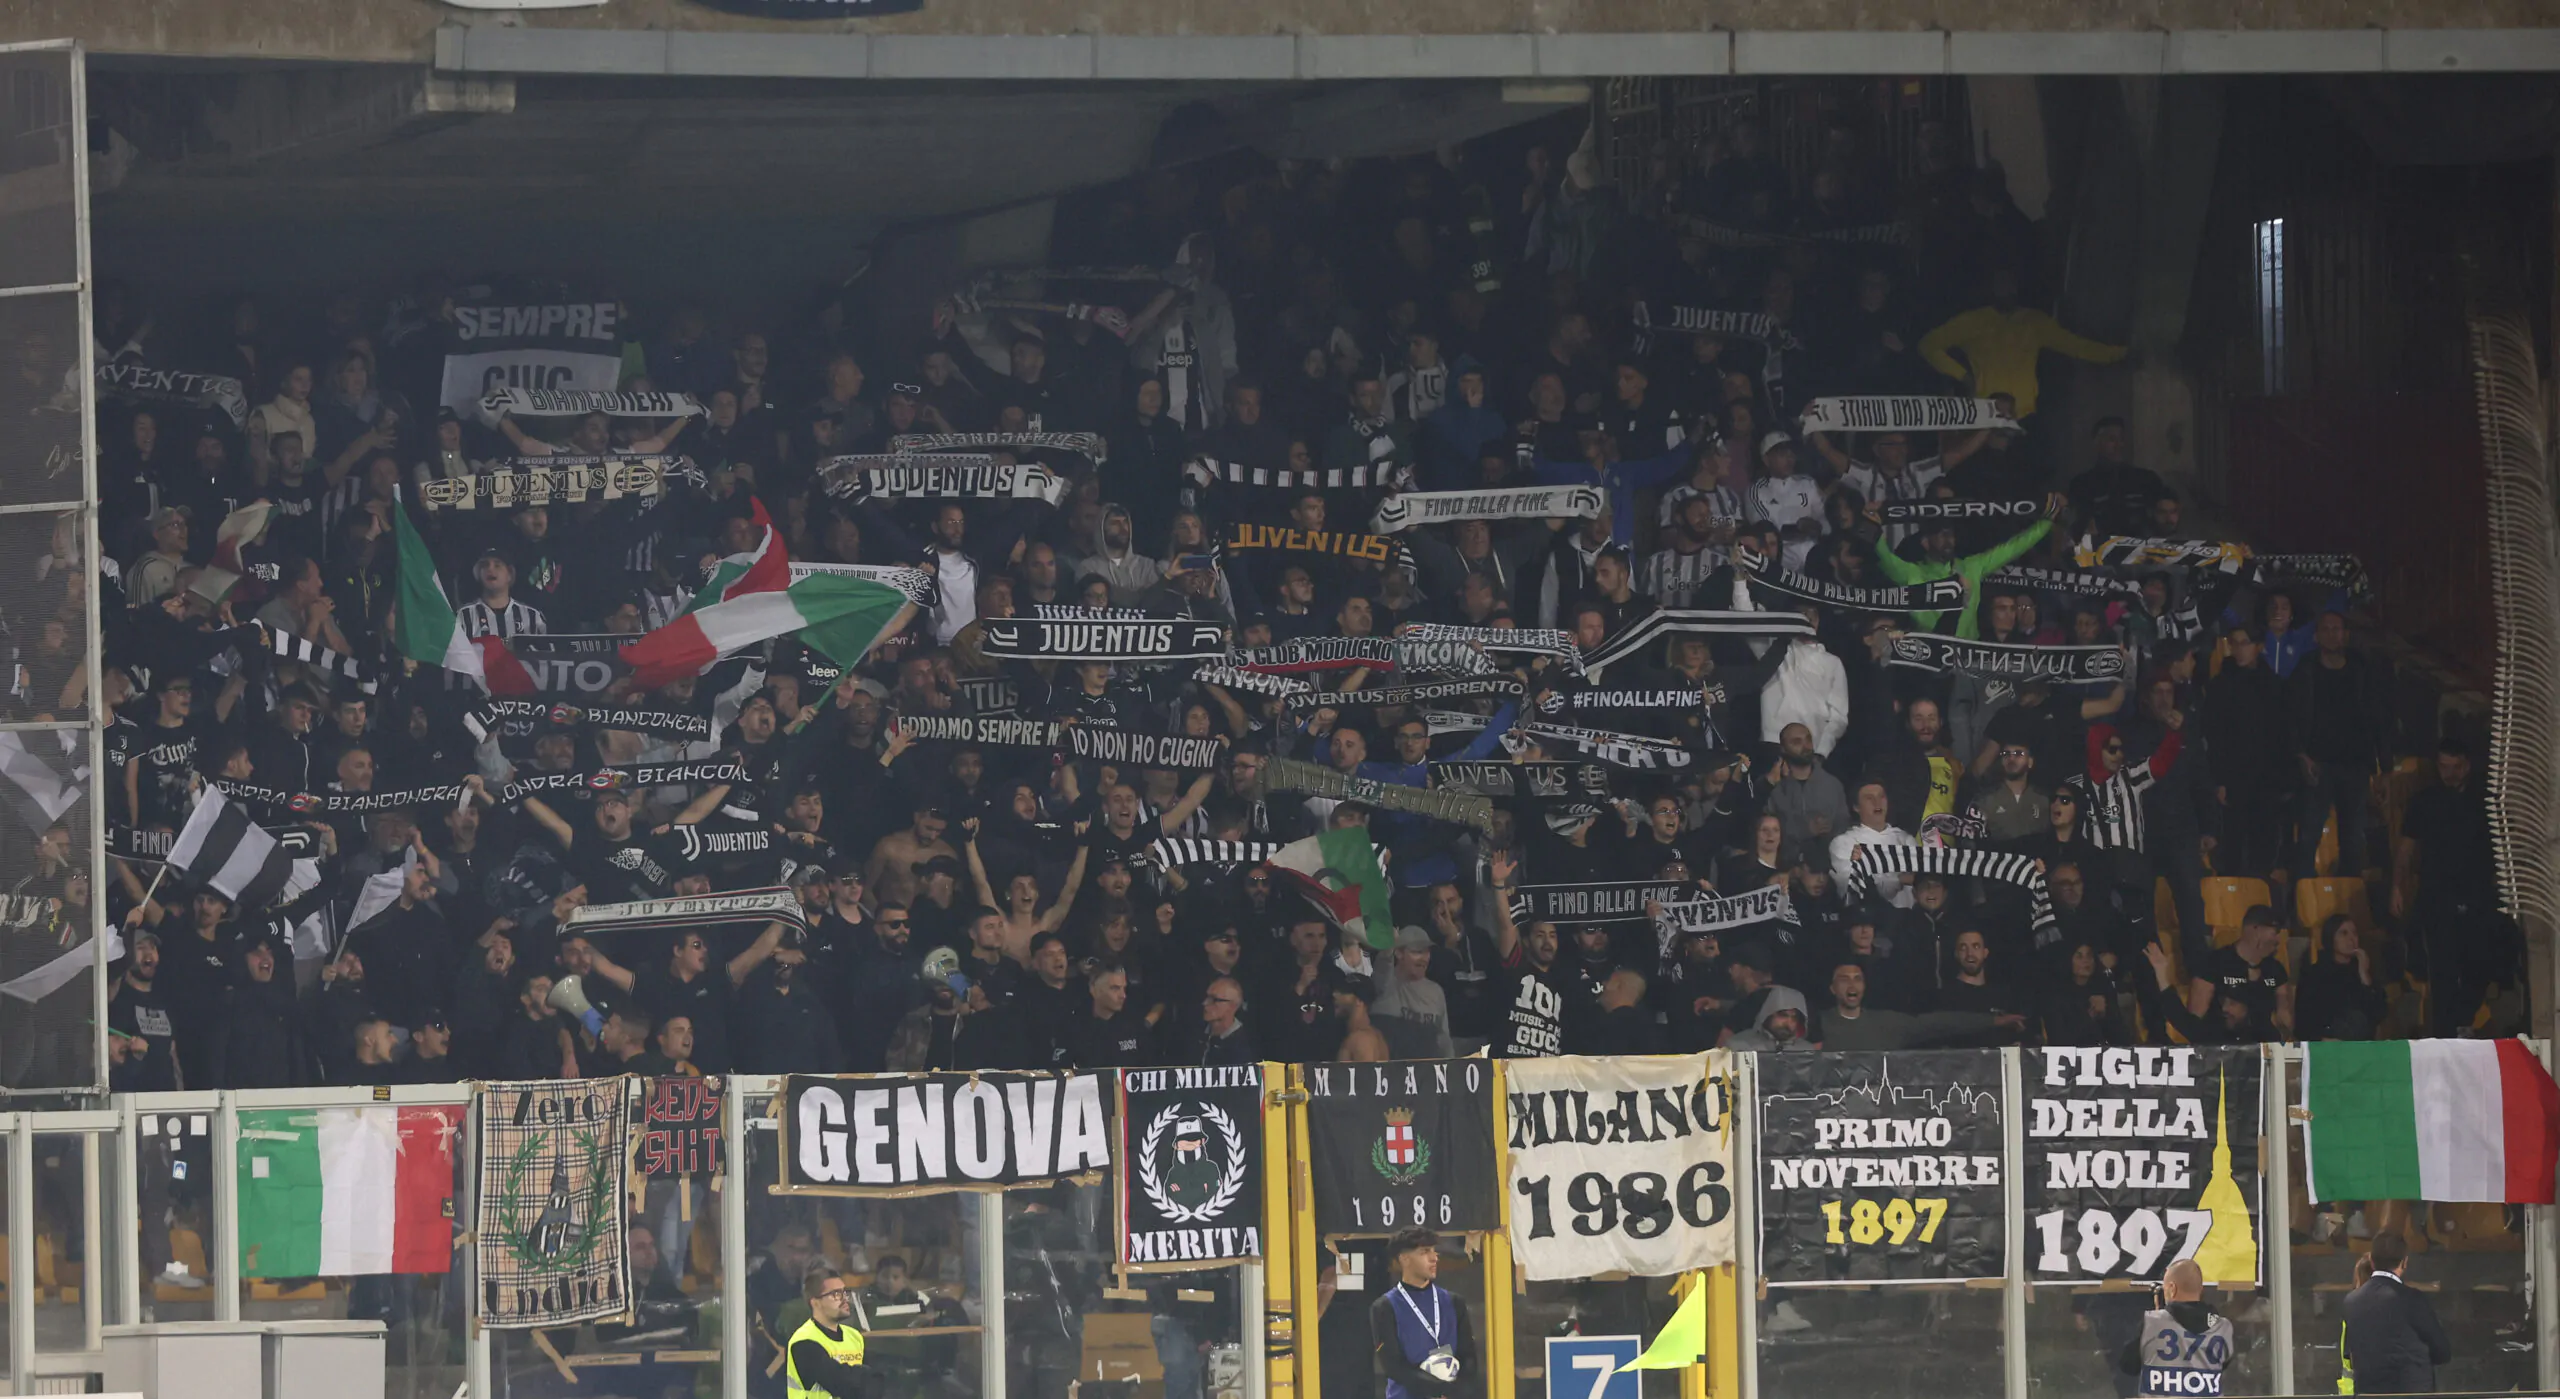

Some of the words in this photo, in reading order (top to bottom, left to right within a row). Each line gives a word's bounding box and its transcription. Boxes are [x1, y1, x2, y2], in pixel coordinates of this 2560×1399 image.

[456, 303, 616, 341] SEMPRE
[1672, 305, 1774, 337] JUVENTUS
[1158, 352, 1193, 368] Jeep
[477, 467, 607, 497] JUVENTUS
[873, 465, 1014, 492] JUVENTUS
[1425, 498, 1464, 517] FINO
[1466, 496, 1510, 515] ALLA
[1513, 492, 1554, 512] FINE
[1888, 501, 2036, 518] SIDERNO
[1228, 524, 1391, 561] JUVENTUS
[1039, 624, 1172, 653] JUVENTUS
[1254, 646, 1300, 666] CLUB
[1305, 638, 1393, 664] MODUGNO
[525, 660, 613, 692] NTO
[1288, 689, 1384, 710] JUVENTUS
[1414, 680, 1523, 699] SORRENTO
[1573, 690, 1703, 708] #FINOALLAFINE
[978, 720, 1043, 746] SEMPRE
[1092, 730, 1128, 762] NON
[1132, 734, 1154, 764] HO
[1159, 736, 1219, 768] CUGINI
[217, 781, 286, 804] ONDRA
[502, 773, 584, 804] ONDRA
[132, 829, 172, 855] FINO
[706, 830, 769, 852] JUVENTUS
[1548, 891, 1588, 915] FINO
[1594, 889, 1635, 913] ALLA
[1508, 1010, 1545, 1028] MUSIC
[1125, 1071, 1167, 1093] CHI
[1175, 1065, 1259, 1089] MILITA
[1314, 1063, 1480, 1098] MILANO
[2041, 1046, 2196, 1088] FIGLI
[512, 1090, 606, 1127] Zero
[645, 1079, 720, 1123] REDS
[1509, 1076, 1728, 1149] MILANO
[799, 1073, 1110, 1184] GENOVA
[1814, 1117, 1951, 1149] PRIMO
[2029, 1098, 2208, 1138] DELLA
[1770, 1155, 1999, 1190] NOVEMBRE
[2046, 1150, 2190, 1188] MOLE
[1352, 1194, 1452, 1226] 1986
[1517, 1161, 1731, 1241] 1986
[1822, 1198, 1947, 1245] 1897
[1129, 1226, 1259, 1263] MERITA
[2035, 1208, 2213, 1275] 1897
[2157, 1329, 2225, 1364] 370
[1571, 1354, 1617, 1398] 7
